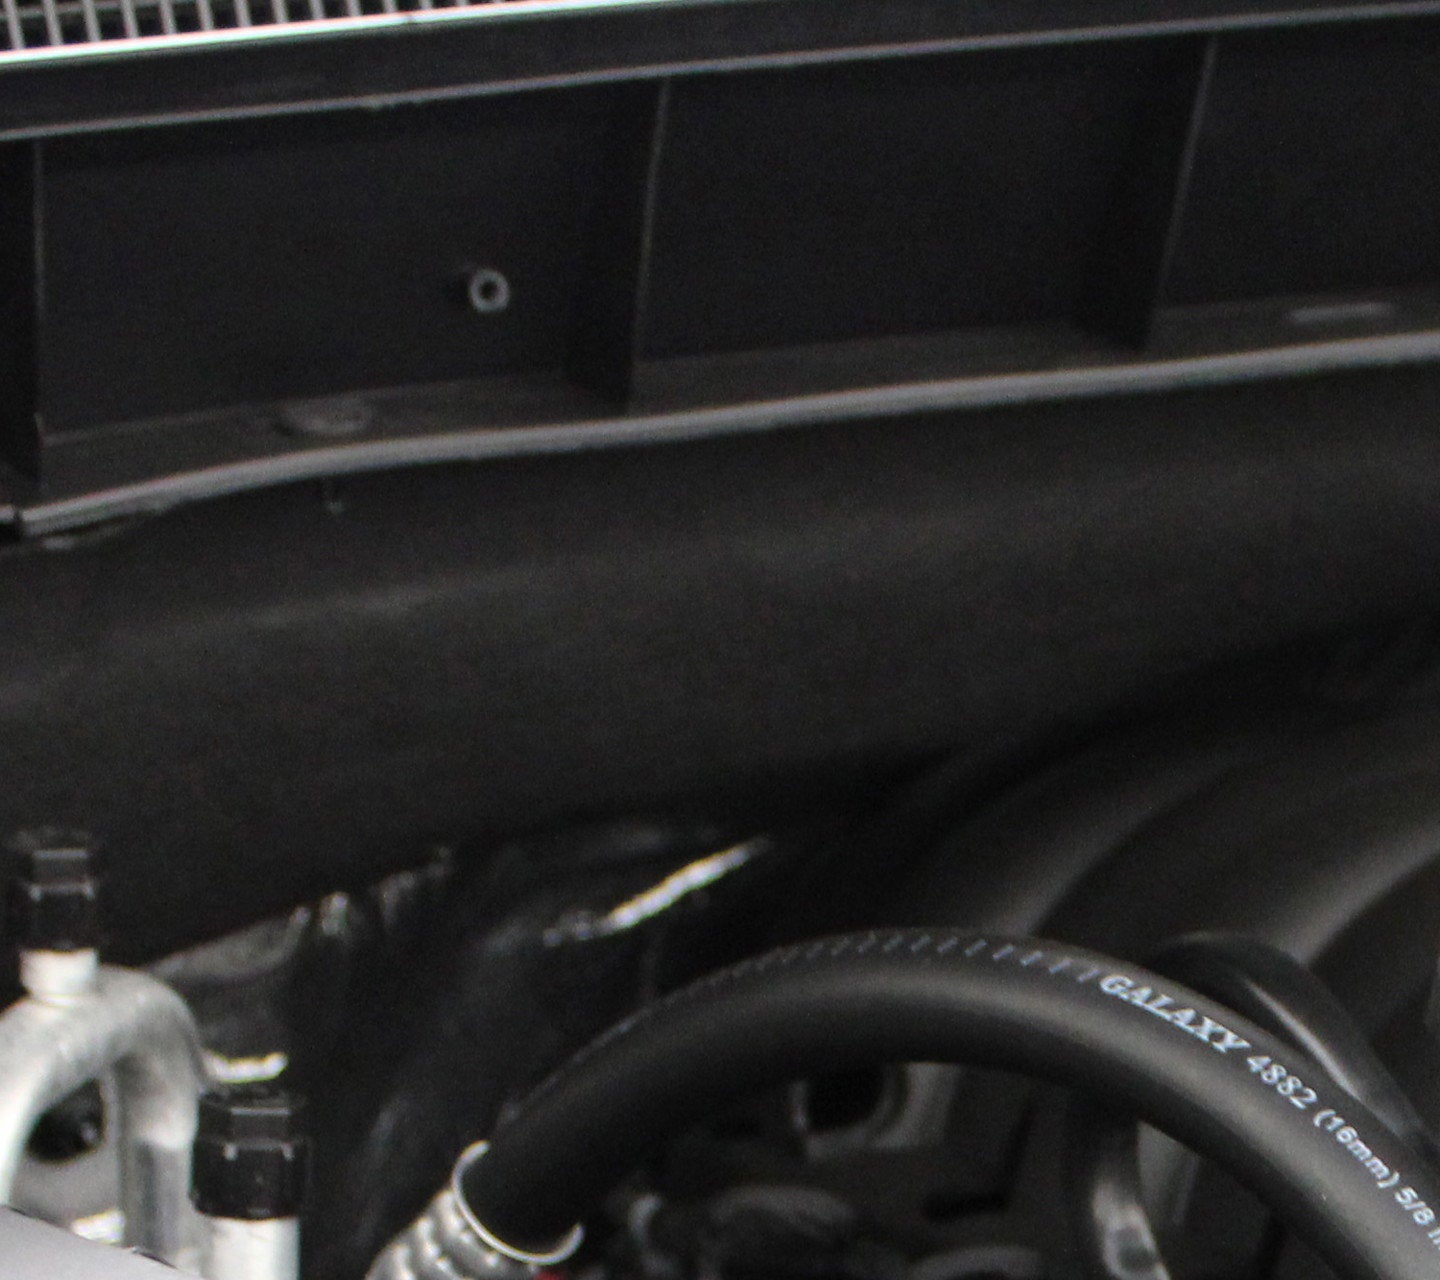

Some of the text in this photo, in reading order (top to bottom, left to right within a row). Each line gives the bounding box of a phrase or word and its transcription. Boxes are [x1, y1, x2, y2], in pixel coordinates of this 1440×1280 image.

[1100, 975, 1251, 1053] GALAXY
[1313, 1108, 1400, 1189] (16mm)
[1394, 1186, 1436, 1226] 5/8
